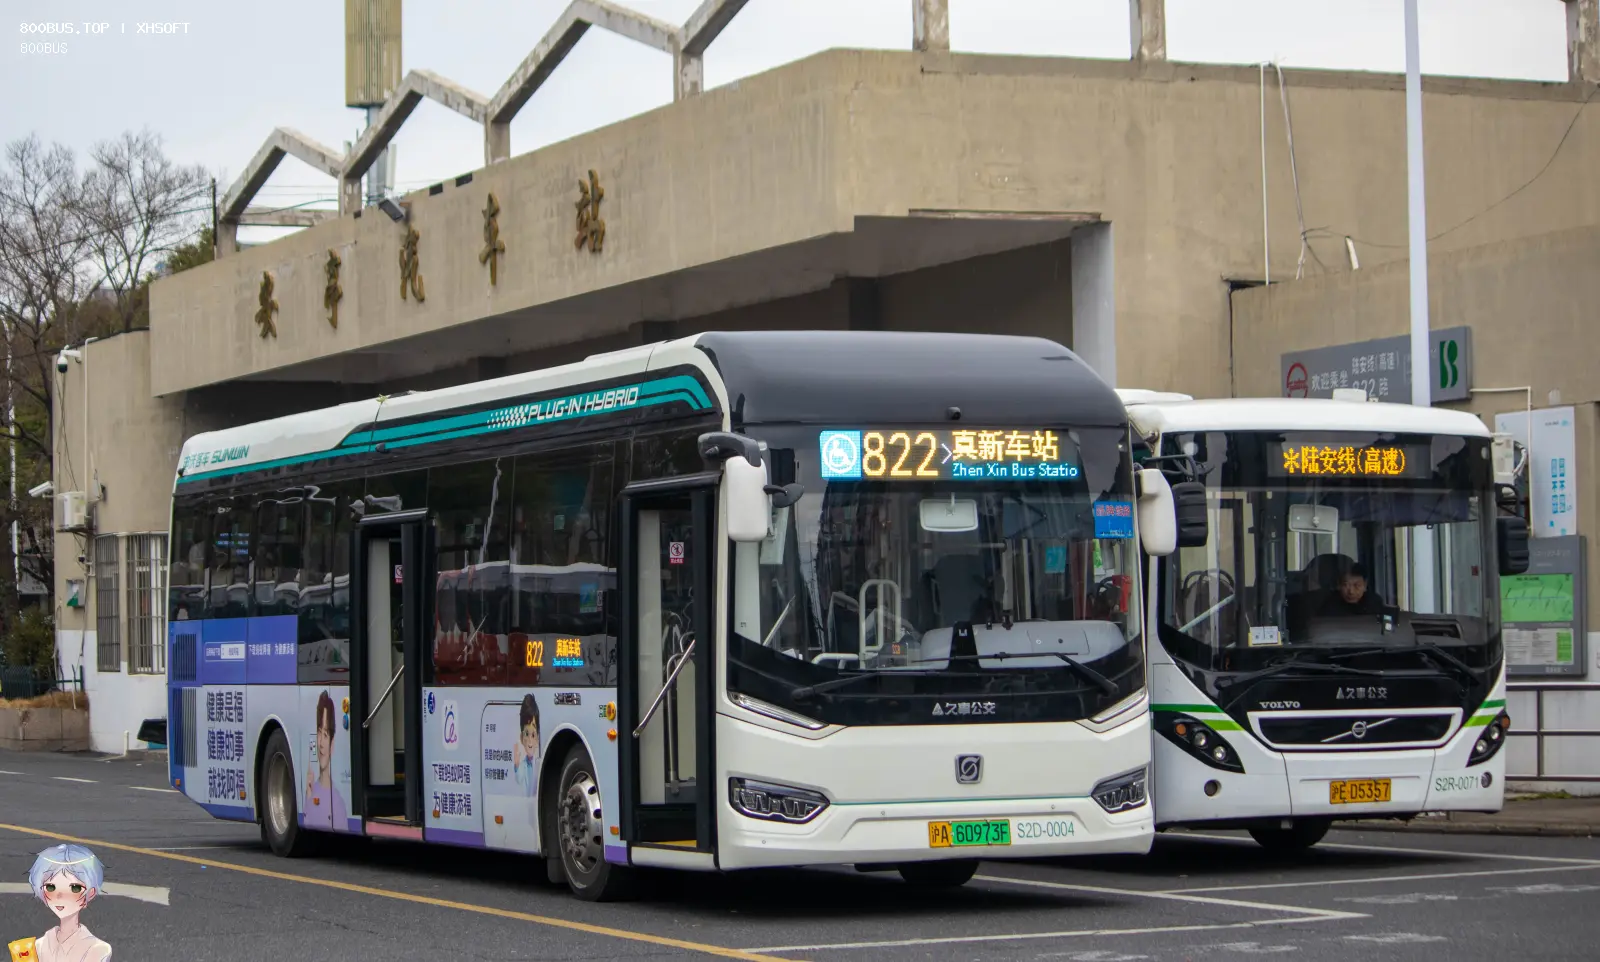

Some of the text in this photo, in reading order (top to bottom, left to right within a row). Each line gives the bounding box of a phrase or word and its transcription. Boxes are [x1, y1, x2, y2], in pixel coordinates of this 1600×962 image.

[1311, 369, 1349, 392] 欢迎乘坐
[527, 386, 639, 422] PLUG-IN HYBRID
[211, 444, 250, 464] SUNWIN
[862, 429, 1059, 477] 822 真新车站
[952, 462, 1078, 477] Zhen Xin Bus Statio
[526, 640, 544, 667] 822
[556, 638, 581, 658] 真新车站
[206, 690, 244, 723] 健康是福
[1259, 700, 1301, 709] VOLVO
[207, 728, 244, 762] 健康的事
[432, 763, 471, 784] 下载蚂蚁阿福
[1435, 776, 1479, 792] S2R-0071
[433, 790, 472, 816] 为健康添福
[1017, 821, 1075, 838] S2D-0004
